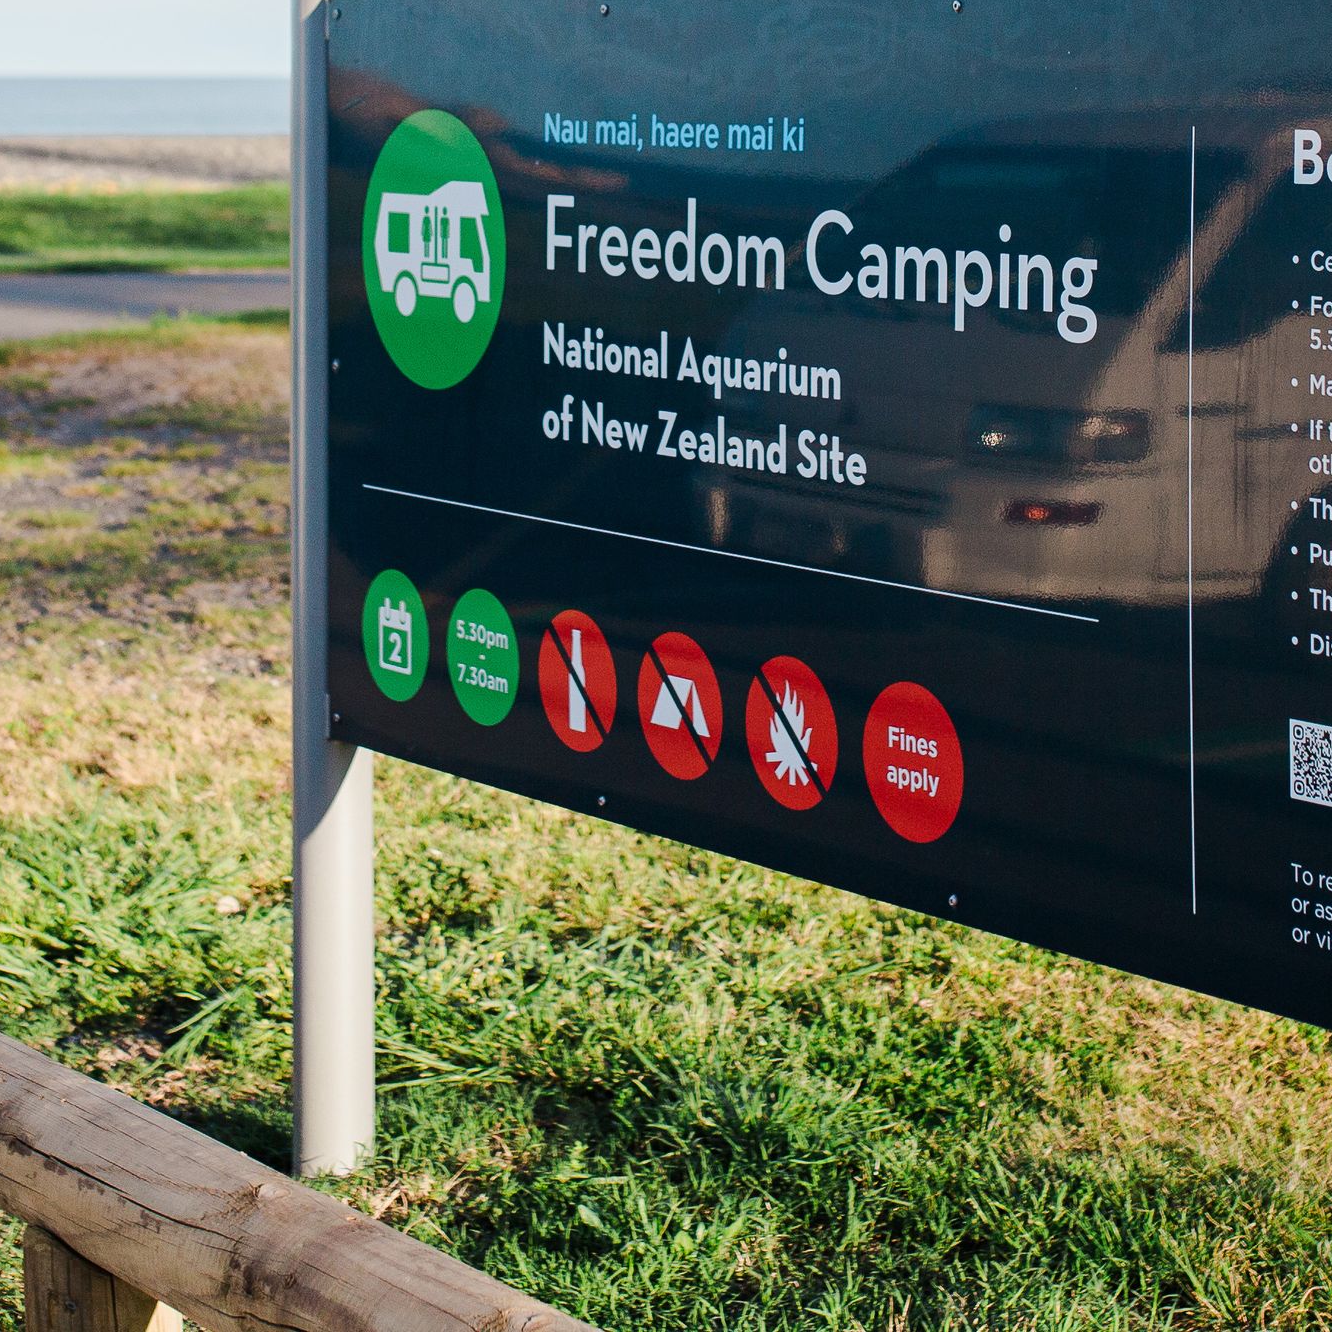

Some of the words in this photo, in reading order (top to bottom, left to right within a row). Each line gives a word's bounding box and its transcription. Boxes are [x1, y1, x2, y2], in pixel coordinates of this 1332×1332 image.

[544, 112, 588, 144] Nau
[595, 113, 643, 152] mai,
[651, 113, 720, 149] haere
[728, 117, 774, 151] mai
[782, 117, 805, 152] ki
[546, 193, 785, 290] Freedom
[805, 209, 1098, 344] Camping
[543, 321, 668, 379] National
[676, 336, 841, 401] Aquarium
[542, 394, 575, 441] of
[581, 399, 649, 453] New
[656, 410, 787, 475] Zealand
[796, 429, 867, 486] Site
[1309, 419, 1324, 441] If
[388, 632, 402, 663] 2
[456, 619, 509, 650] 5.30pm
[457, 663, 509, 694] 7.30am
[888, 725, 938, 758] Fines
[886, 765, 940, 798] apply
[1290, 862, 1314, 886] To
[1291, 897, 1310, 914] or
[1291, 927, 1311, 944] or
